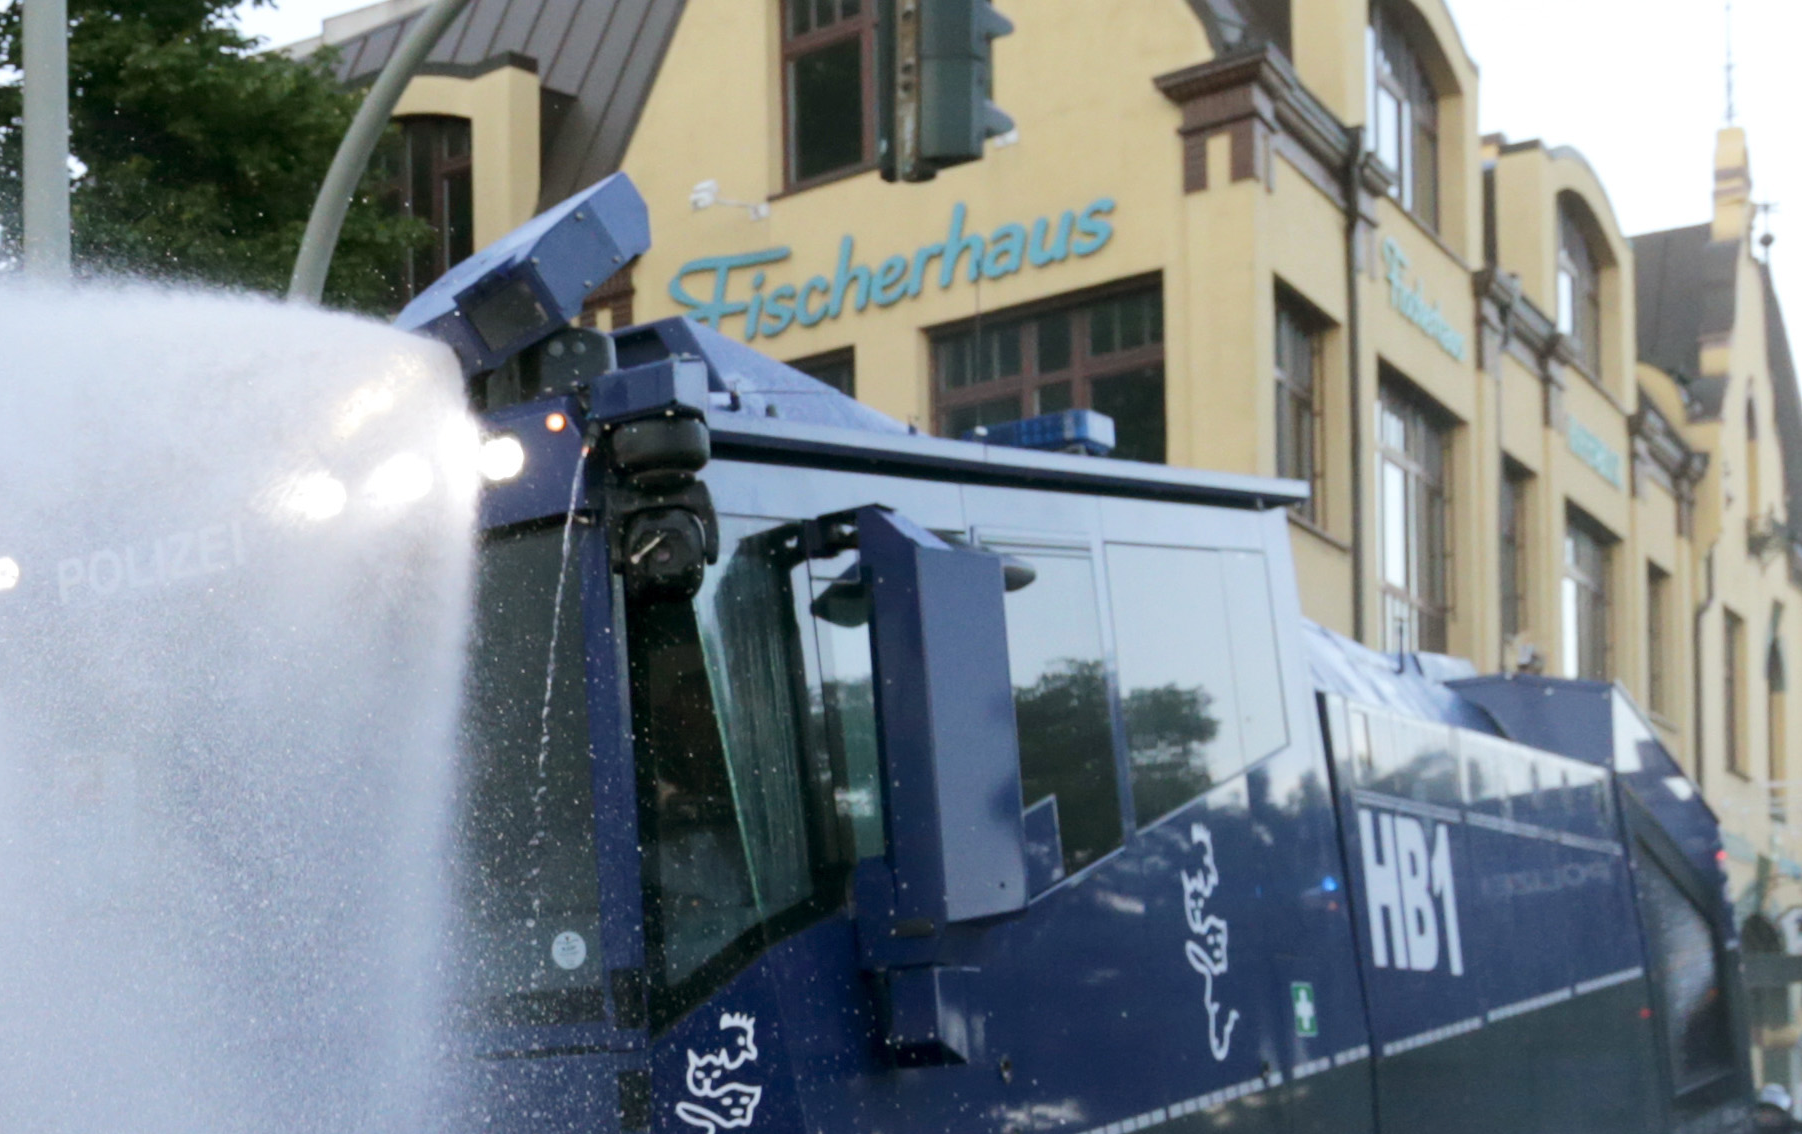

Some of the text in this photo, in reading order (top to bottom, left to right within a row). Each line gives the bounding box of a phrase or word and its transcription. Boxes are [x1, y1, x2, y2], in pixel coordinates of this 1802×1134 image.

[669, 197, 1116, 340] Fischerhaus
[57, 519, 246, 602] POLIZEI
[1359, 808, 1464, 976] HB1
